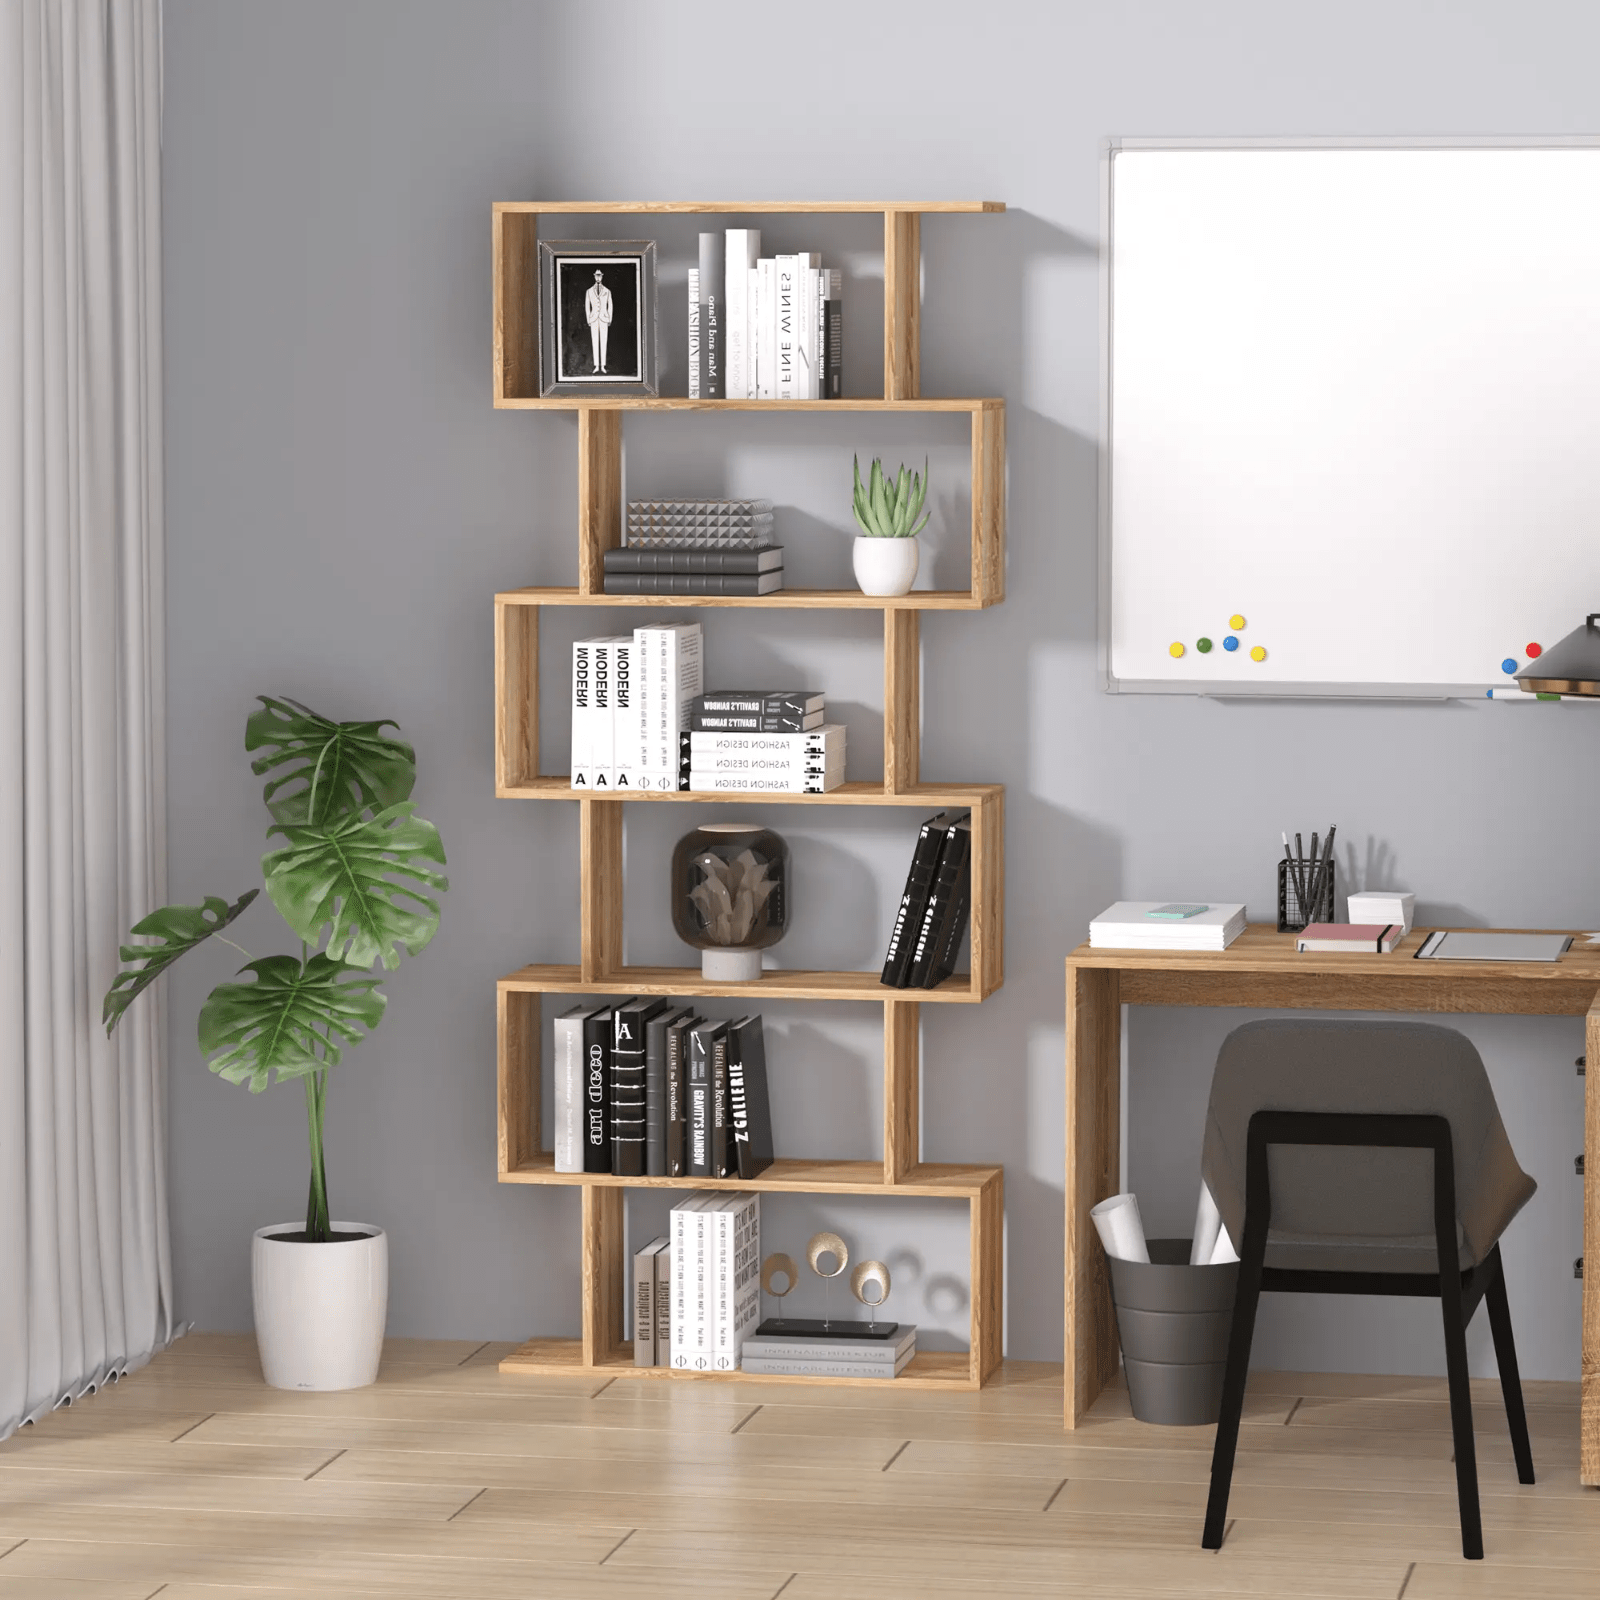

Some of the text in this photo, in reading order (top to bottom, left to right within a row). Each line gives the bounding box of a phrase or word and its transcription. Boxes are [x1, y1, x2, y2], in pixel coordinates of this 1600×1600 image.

[689, 270, 699, 297] THE
[689, 301, 699, 357] FASHION
[903, 894, 910, 906] Z
[929, 895, 937, 906] Z
[618, 1023, 633, 1040] A
[715, 1044, 724, 1078] REVEALING
[589, 1044, 603, 1145] art deco
[715, 1089, 724, 1128] Revolution
[729, 1062, 749, 1142] Z GALLERIE
[694, 1090, 704, 1166] GRAVITY'S RAINBOW
